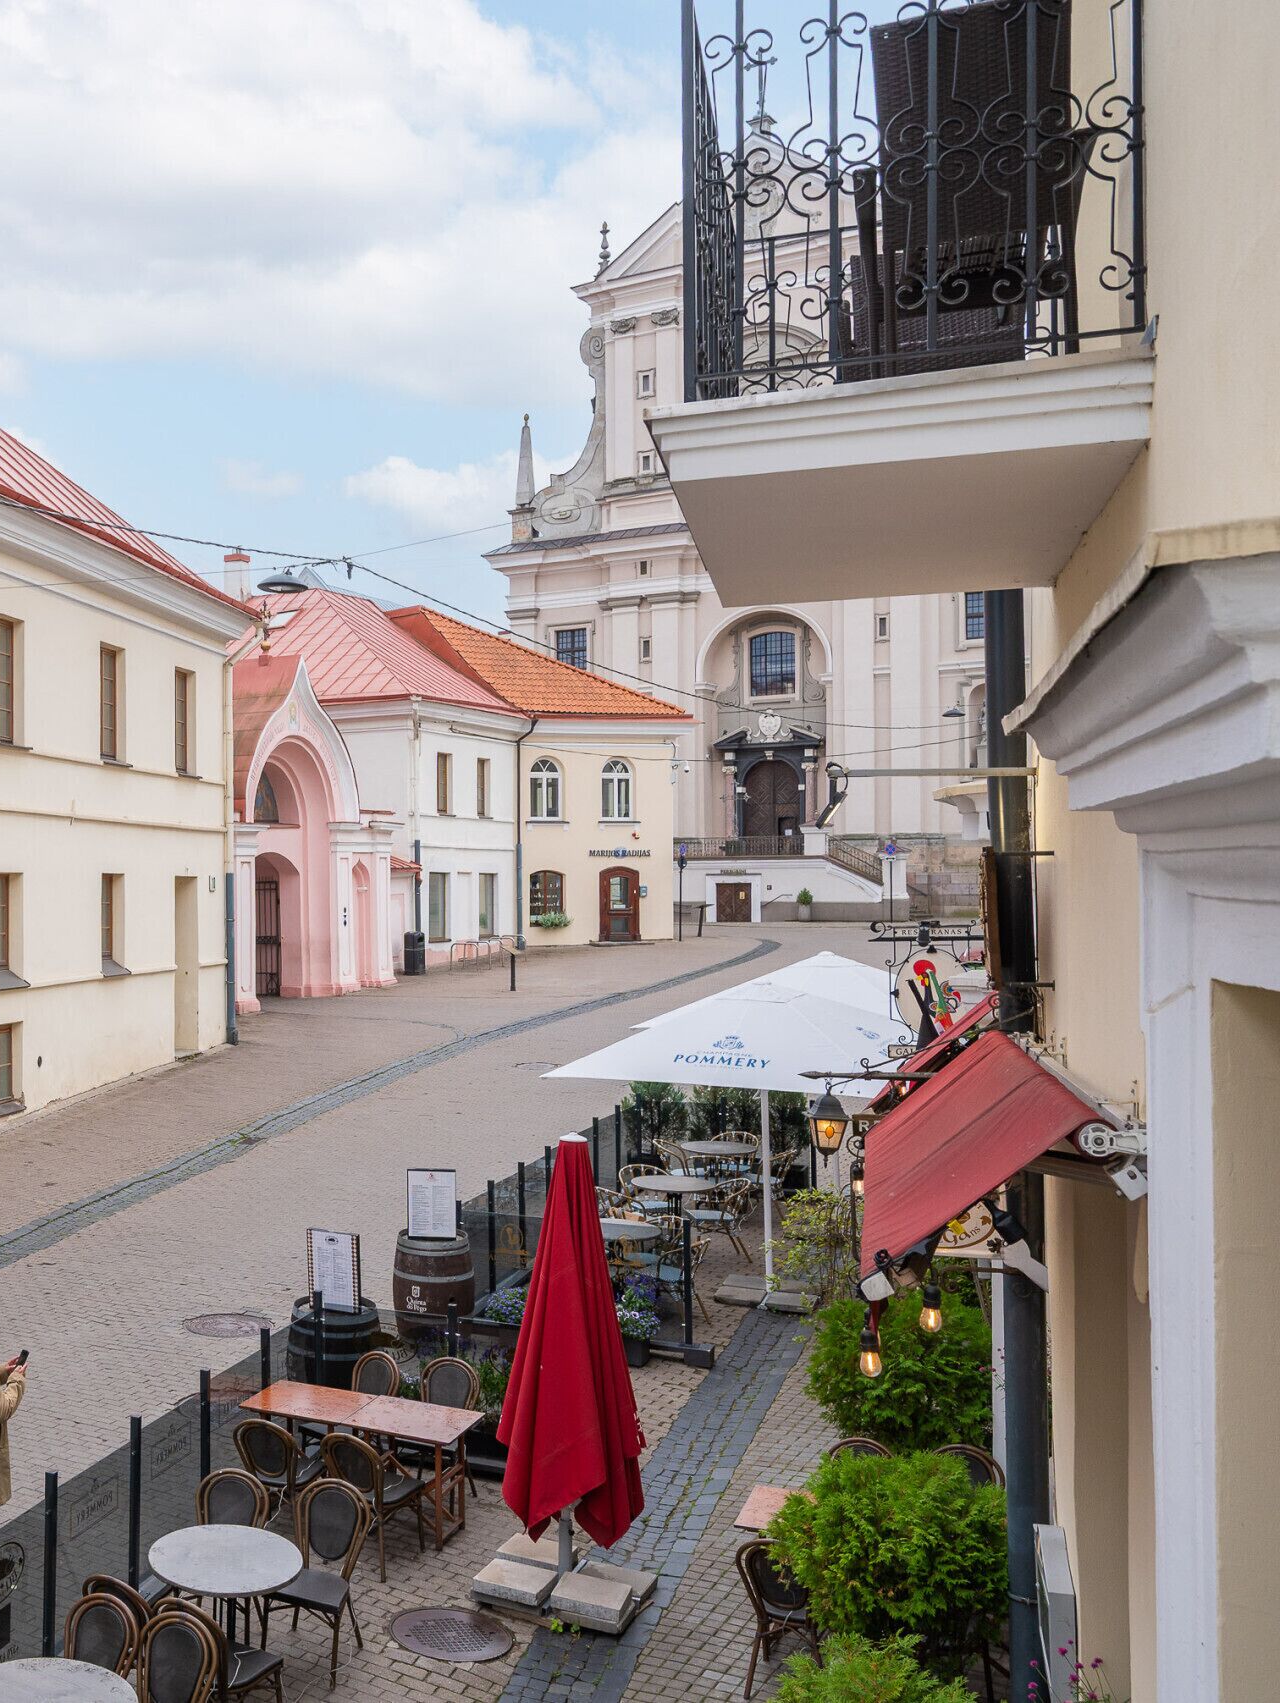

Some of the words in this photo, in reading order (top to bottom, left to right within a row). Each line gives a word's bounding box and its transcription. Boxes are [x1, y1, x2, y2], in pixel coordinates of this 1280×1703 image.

[589, 849, 620, 858] MARIJOS
[621, 849, 651, 858] RADIJAS
[901, 928, 962, 936] RESRANAS
[673, 1054, 771, 1068] POMMERY
